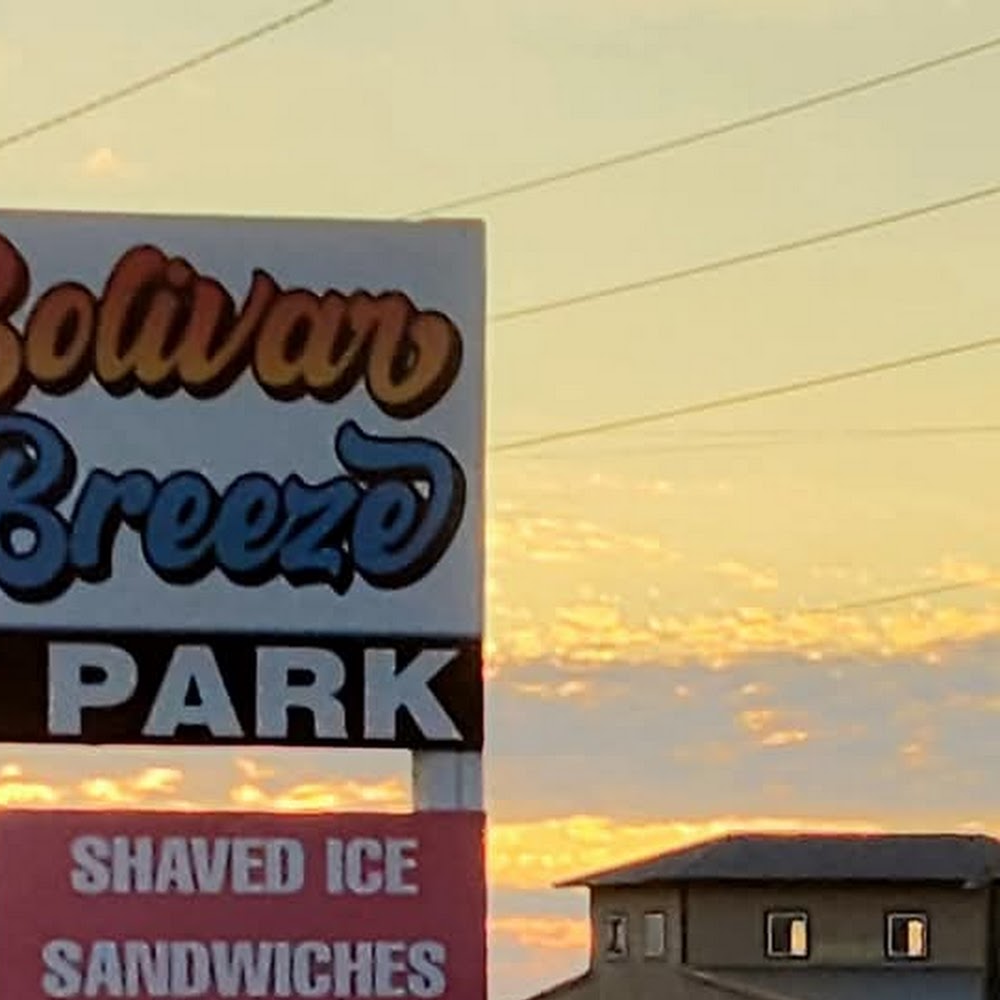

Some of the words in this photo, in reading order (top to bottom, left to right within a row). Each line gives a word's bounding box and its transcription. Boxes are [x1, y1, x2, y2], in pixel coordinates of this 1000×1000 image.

[46, 642, 462, 742] PARK
[70, 836, 305, 895] SHAVED
[326, 836, 419, 895] ICE
[41, 940, 447, 999] SANDWICHES
